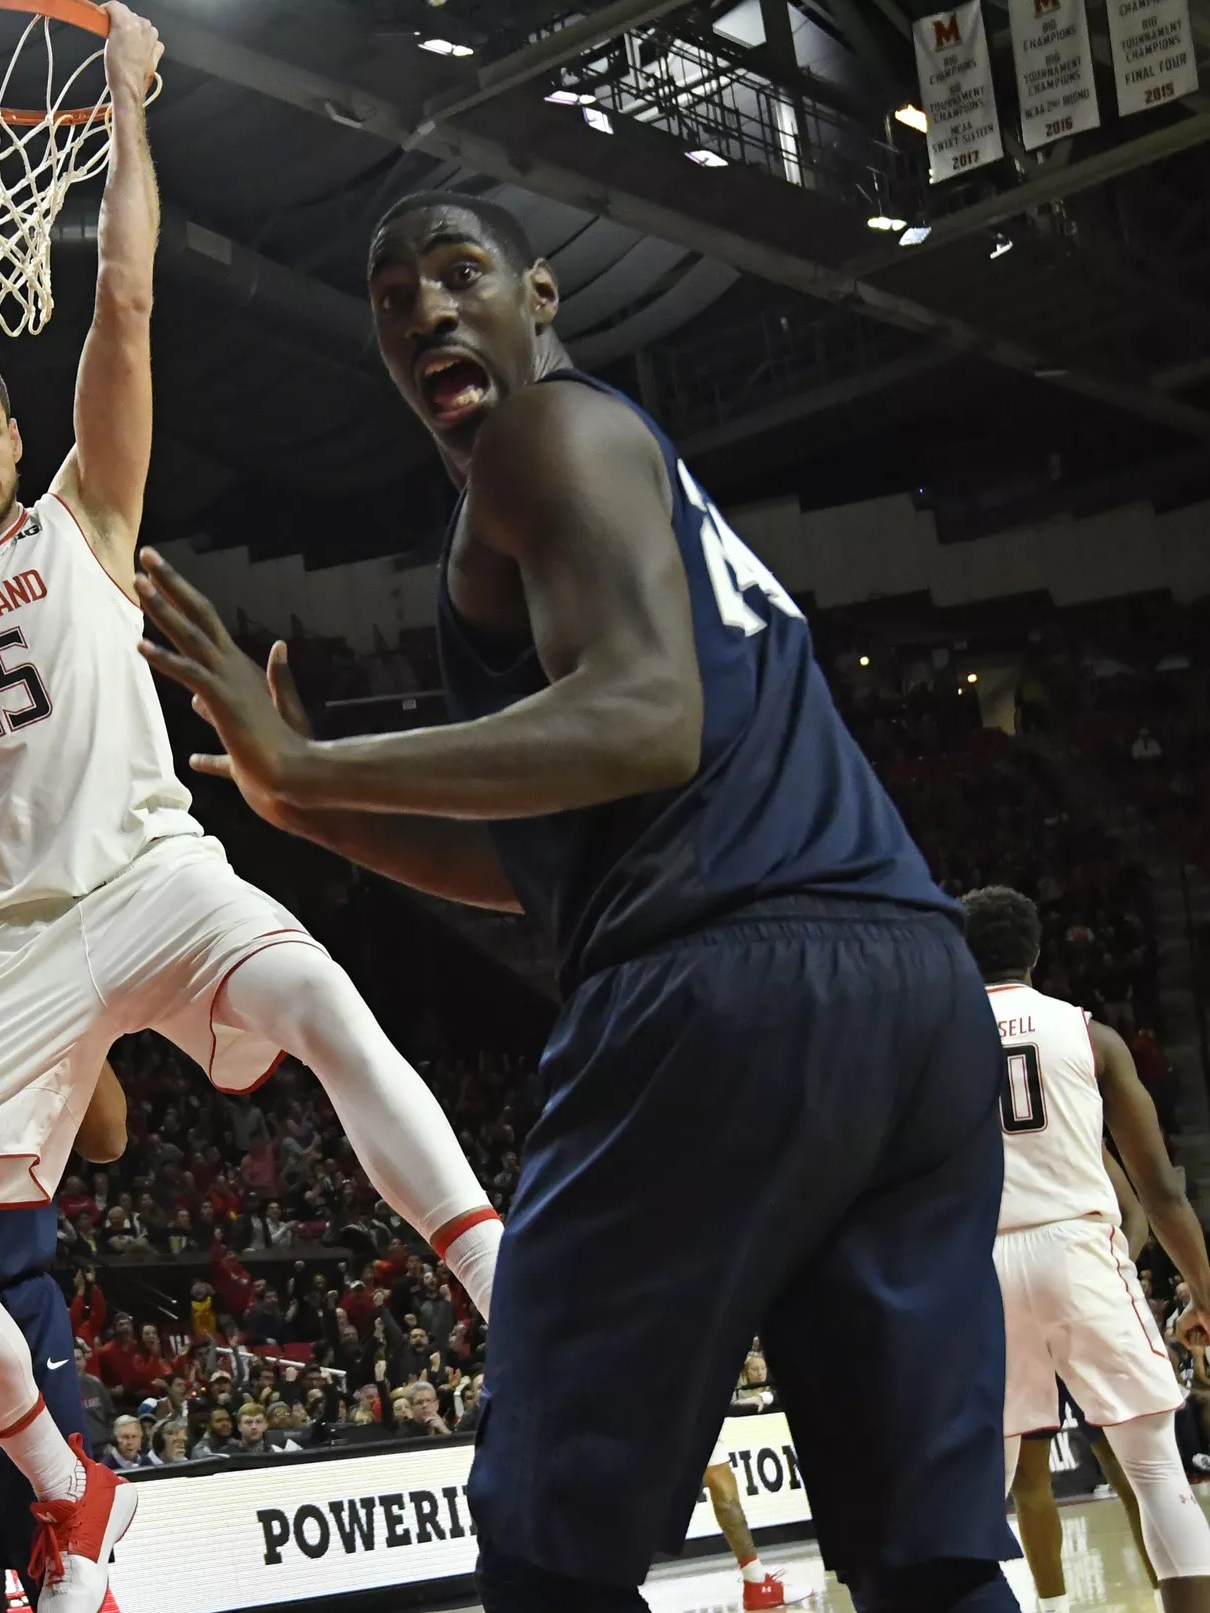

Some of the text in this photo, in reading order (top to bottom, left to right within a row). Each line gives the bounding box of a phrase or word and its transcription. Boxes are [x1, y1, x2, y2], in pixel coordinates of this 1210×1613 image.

[1121, 17, 1182, 51] TOURNAMENT
[1125, 34, 1181, 63] CHAMPIONS
[1124, 52, 1187, 86] FINAL FOUR
[1045, 116, 1074, 137] 2016
[951, 150, 980, 170] 2017
